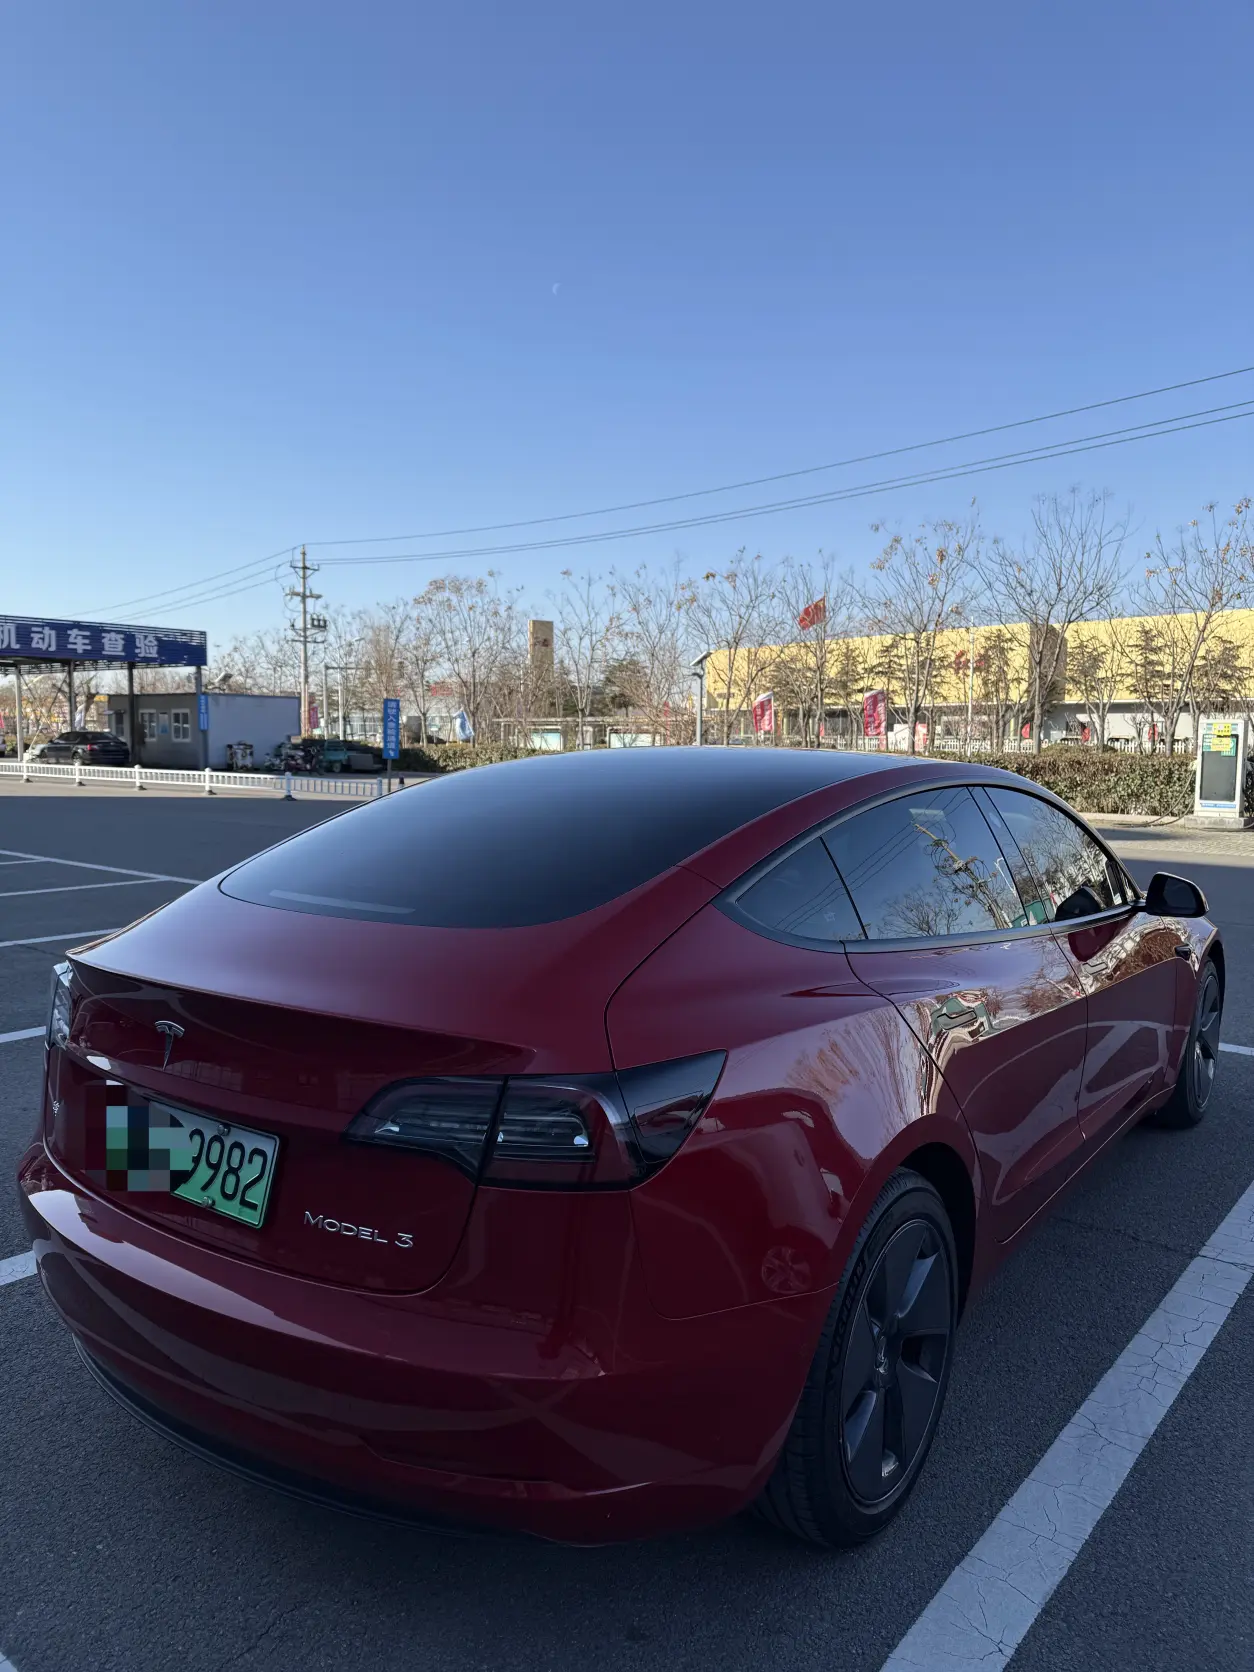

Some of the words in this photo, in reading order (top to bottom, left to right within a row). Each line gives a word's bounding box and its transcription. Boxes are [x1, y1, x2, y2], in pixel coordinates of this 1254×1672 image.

[0, 623, 159, 658] 机动车查验
[303, 1211, 388, 1243] MODEL
[394, 1232, 414, 1248] 3
